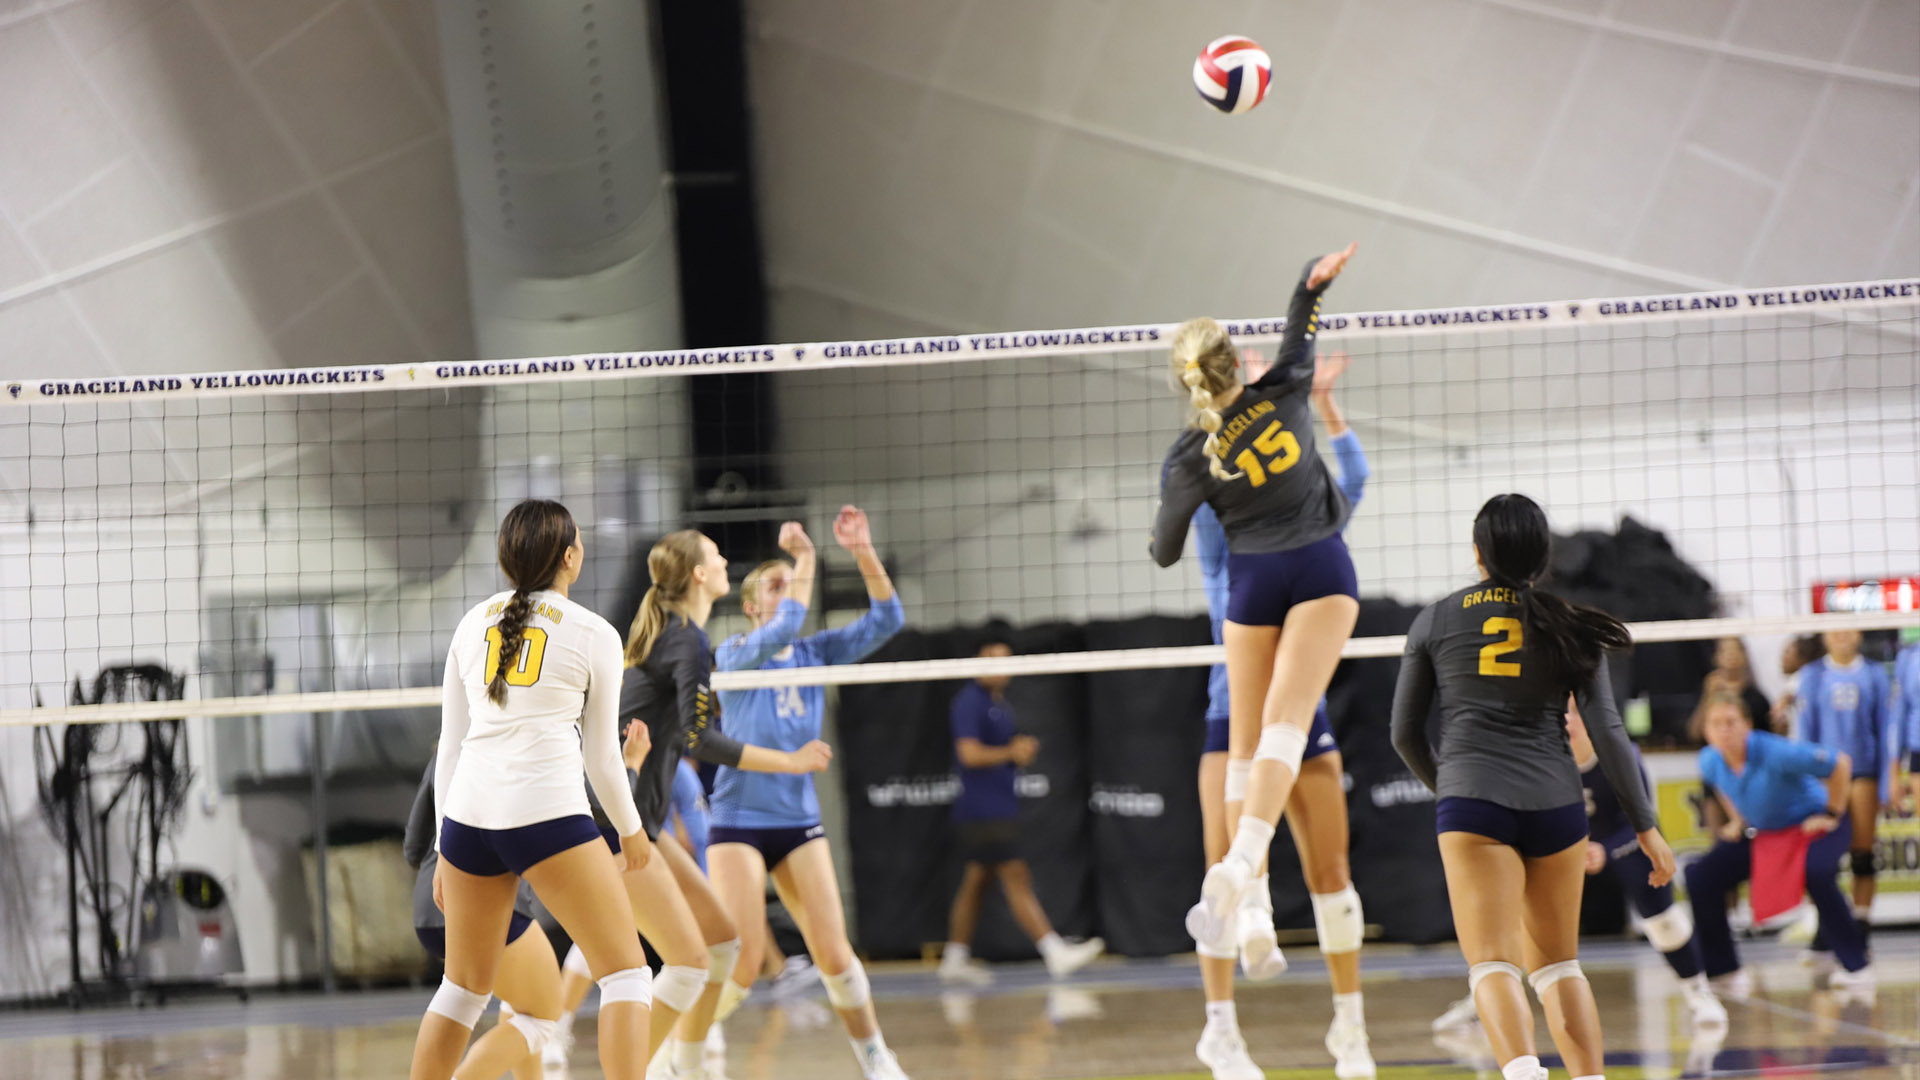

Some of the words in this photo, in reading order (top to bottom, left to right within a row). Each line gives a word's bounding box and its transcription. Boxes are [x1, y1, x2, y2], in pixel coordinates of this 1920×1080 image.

[1599, 295, 1738, 316] GRACELAND
[1747, 282, 1920, 307] YELLOWJACKET
[1227, 317, 1348, 336] RACEND
[1357, 306, 1549, 328] YELLOWJACKETS
[824, 340, 961, 359] GRACELAND
[970, 329, 1160, 350] YELLOWJACKETS
[436, 360, 576, 379] GRACELAND
[584, 349, 775, 372] YELLOWJACKETS
[39, 378, 183, 397] GRACELAND
[190, 368, 386, 390] YELLOWJACKETS
[1234, 419, 1301, 488] 15
[485, 600, 563, 625] GRLAND
[1462, 587, 1519, 609] GRACEL
[1478, 616, 1523, 677] 2
